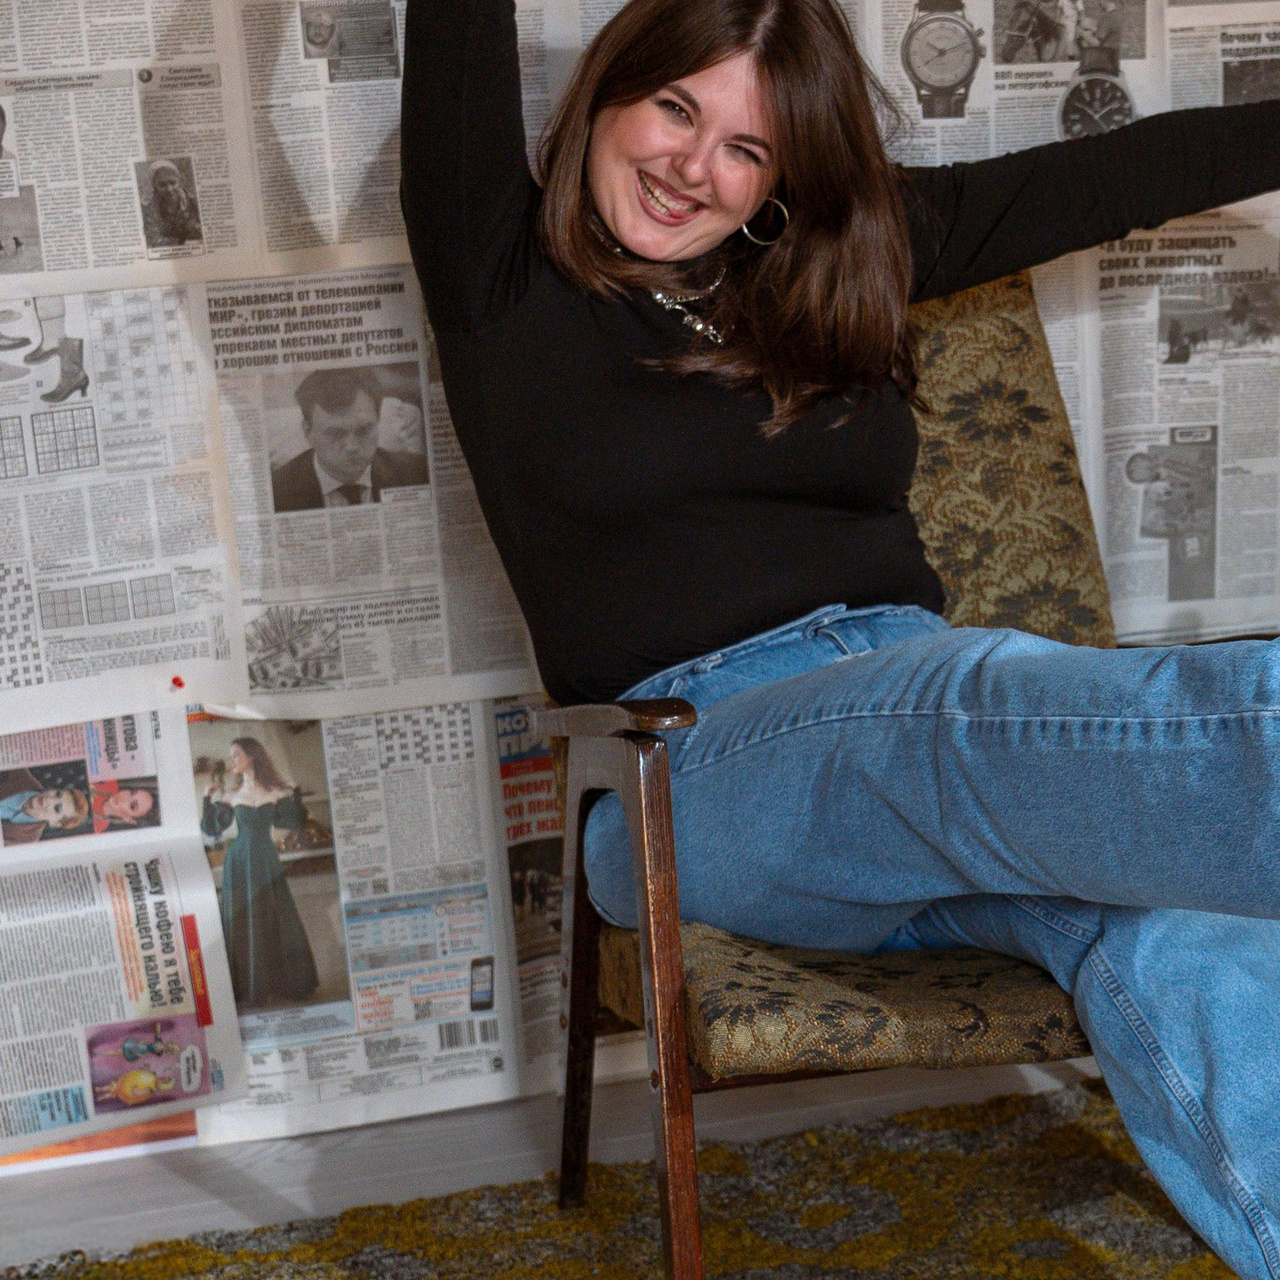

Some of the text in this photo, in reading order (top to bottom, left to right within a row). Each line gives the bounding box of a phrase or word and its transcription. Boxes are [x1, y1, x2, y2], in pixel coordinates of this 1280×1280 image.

[1220, 30, 1263, 46] Почему
[1157, 236, 1237, 251] защищать
[1100, 253, 1224, 271] своих животных
[1117, 272, 1209, 288] последнего
[296, 282, 405, 302] от телекомпании
[250, 297, 382, 322] грозим депортацией
[283, 316, 364, 335] дипломатам
[213, 326, 404, 357] упрекаем местных депутатов
[282, 346, 352, 365] отношения
[355, 347, 363, 358] с
[365, 339, 419, 357] Россией
[166, 971, 187, 1007] тебе
